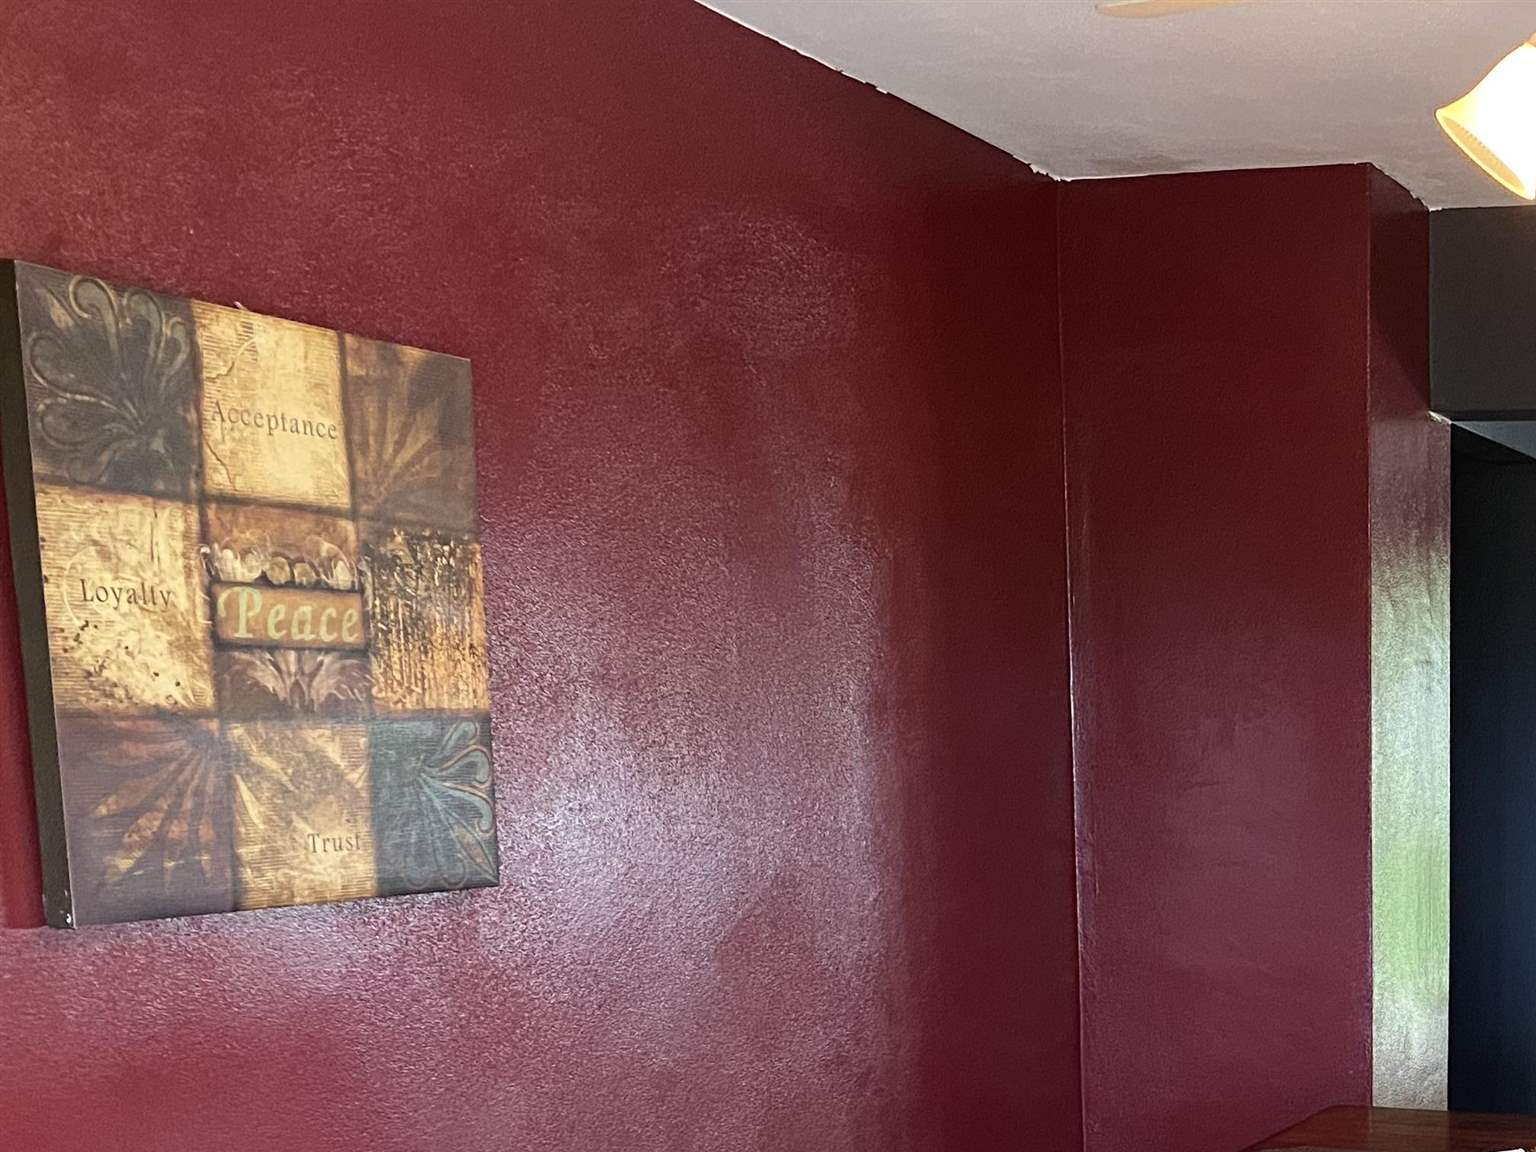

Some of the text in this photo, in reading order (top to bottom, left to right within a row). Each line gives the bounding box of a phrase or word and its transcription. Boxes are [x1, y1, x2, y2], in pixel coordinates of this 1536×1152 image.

[211, 399, 338, 440] Acceptance
[79, 578, 174, 614] Loyalty
[217, 585, 360, 643] Peace
[306, 831, 361, 854] Trust
